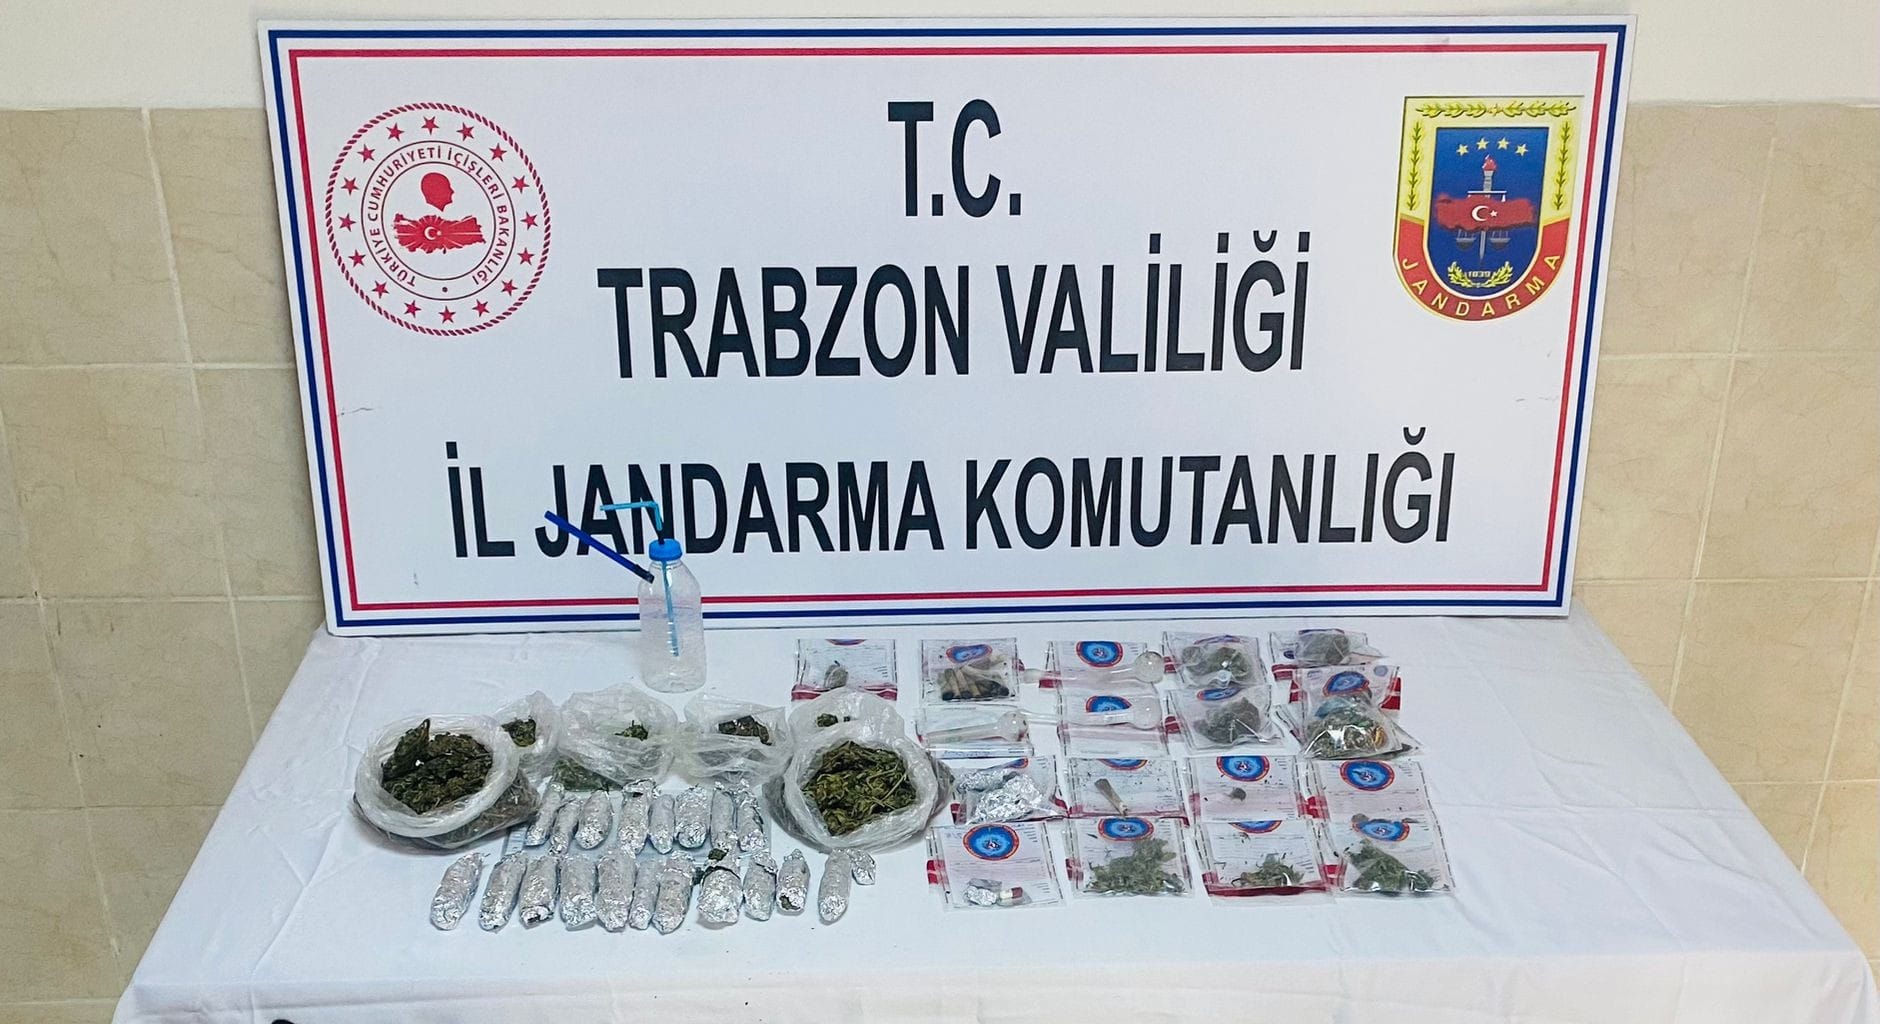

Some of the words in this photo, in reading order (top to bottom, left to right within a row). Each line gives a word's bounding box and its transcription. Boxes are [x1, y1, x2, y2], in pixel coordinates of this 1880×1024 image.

[367, 145, 441, 222] CUMHURİYETİ
[447, 147, 505, 201] İÇİŞLERİ
[887, 98, 1023, 218] T.C.
[368, 227, 416, 287] TÜRKİYE
[472, 204, 510, 286] BAKANLIĞI
[597, 263, 971, 379] TRABZON
[995, 230, 1311, 375] VALİLİĞİ
[1402, 253, 1561, 317] JANDARMA
[445, 441, 516, 558] İL
[534, 460, 945, 558] JANDARMA
[966, 426, 1456, 550] KOMUTANLIĞI
